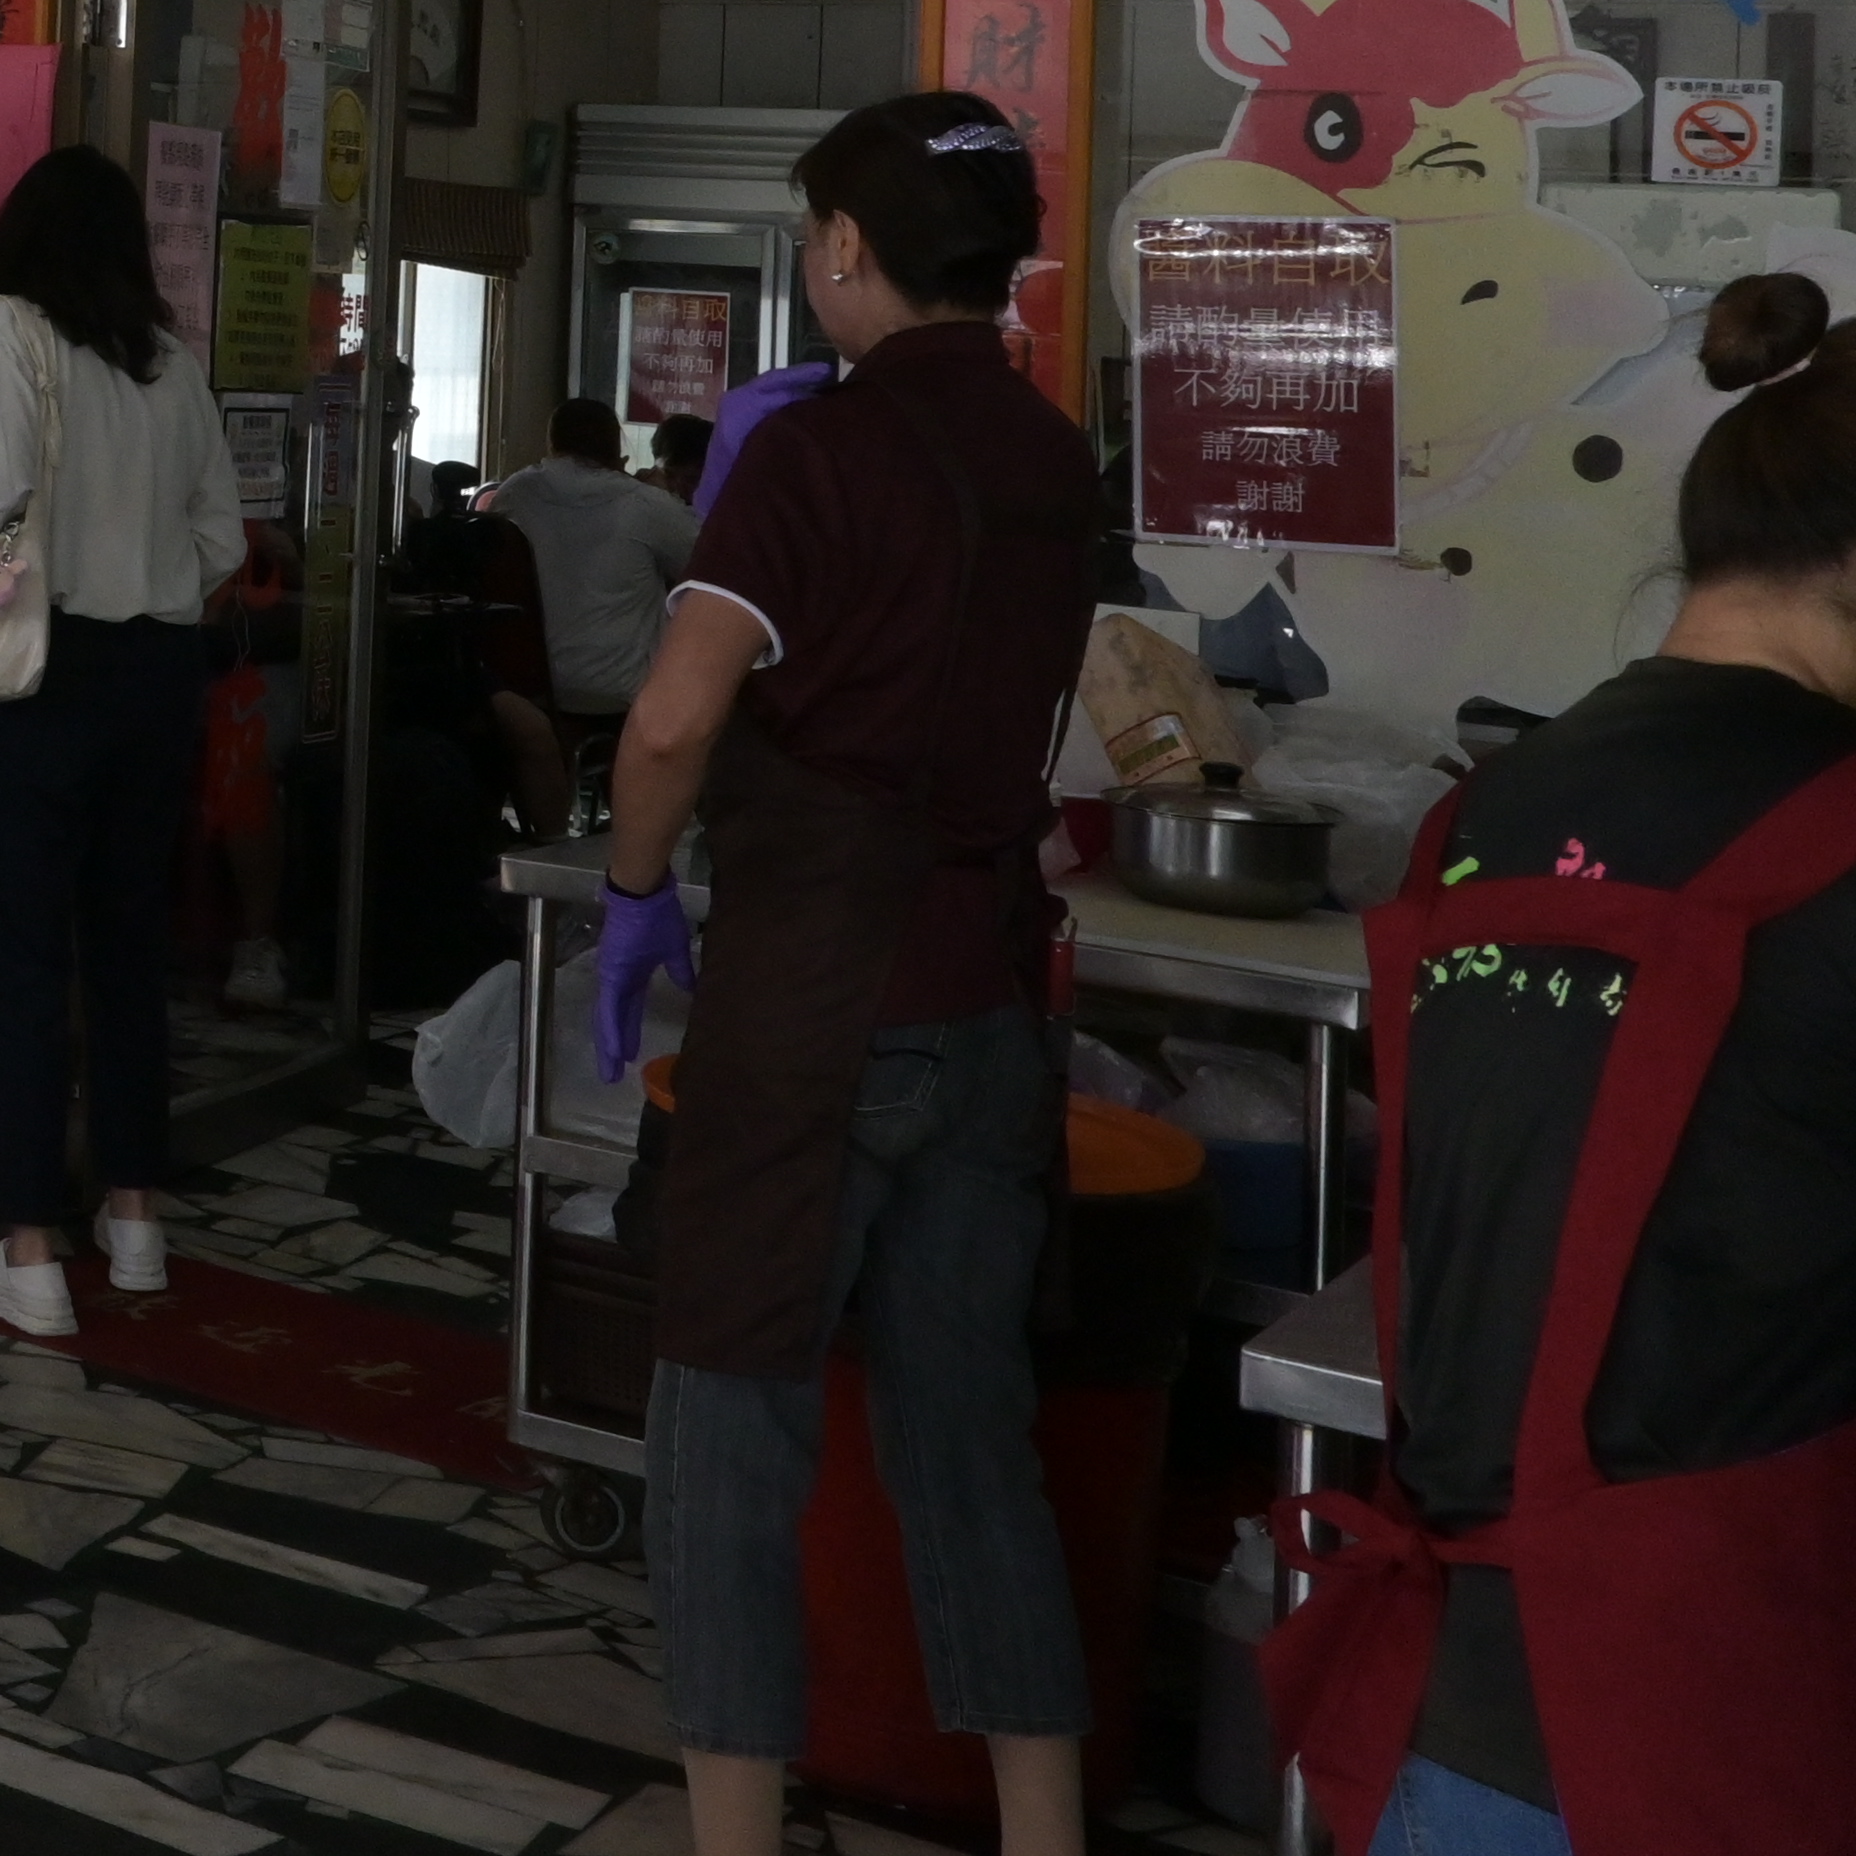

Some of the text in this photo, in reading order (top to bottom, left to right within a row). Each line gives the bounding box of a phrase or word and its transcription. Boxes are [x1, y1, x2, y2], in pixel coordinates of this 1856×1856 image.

[1174, 366, 1359, 413] 不夠再加
[1202, 430, 1342, 466] 請勿浪費
[1236, 480, 1305, 513] 謝謝
